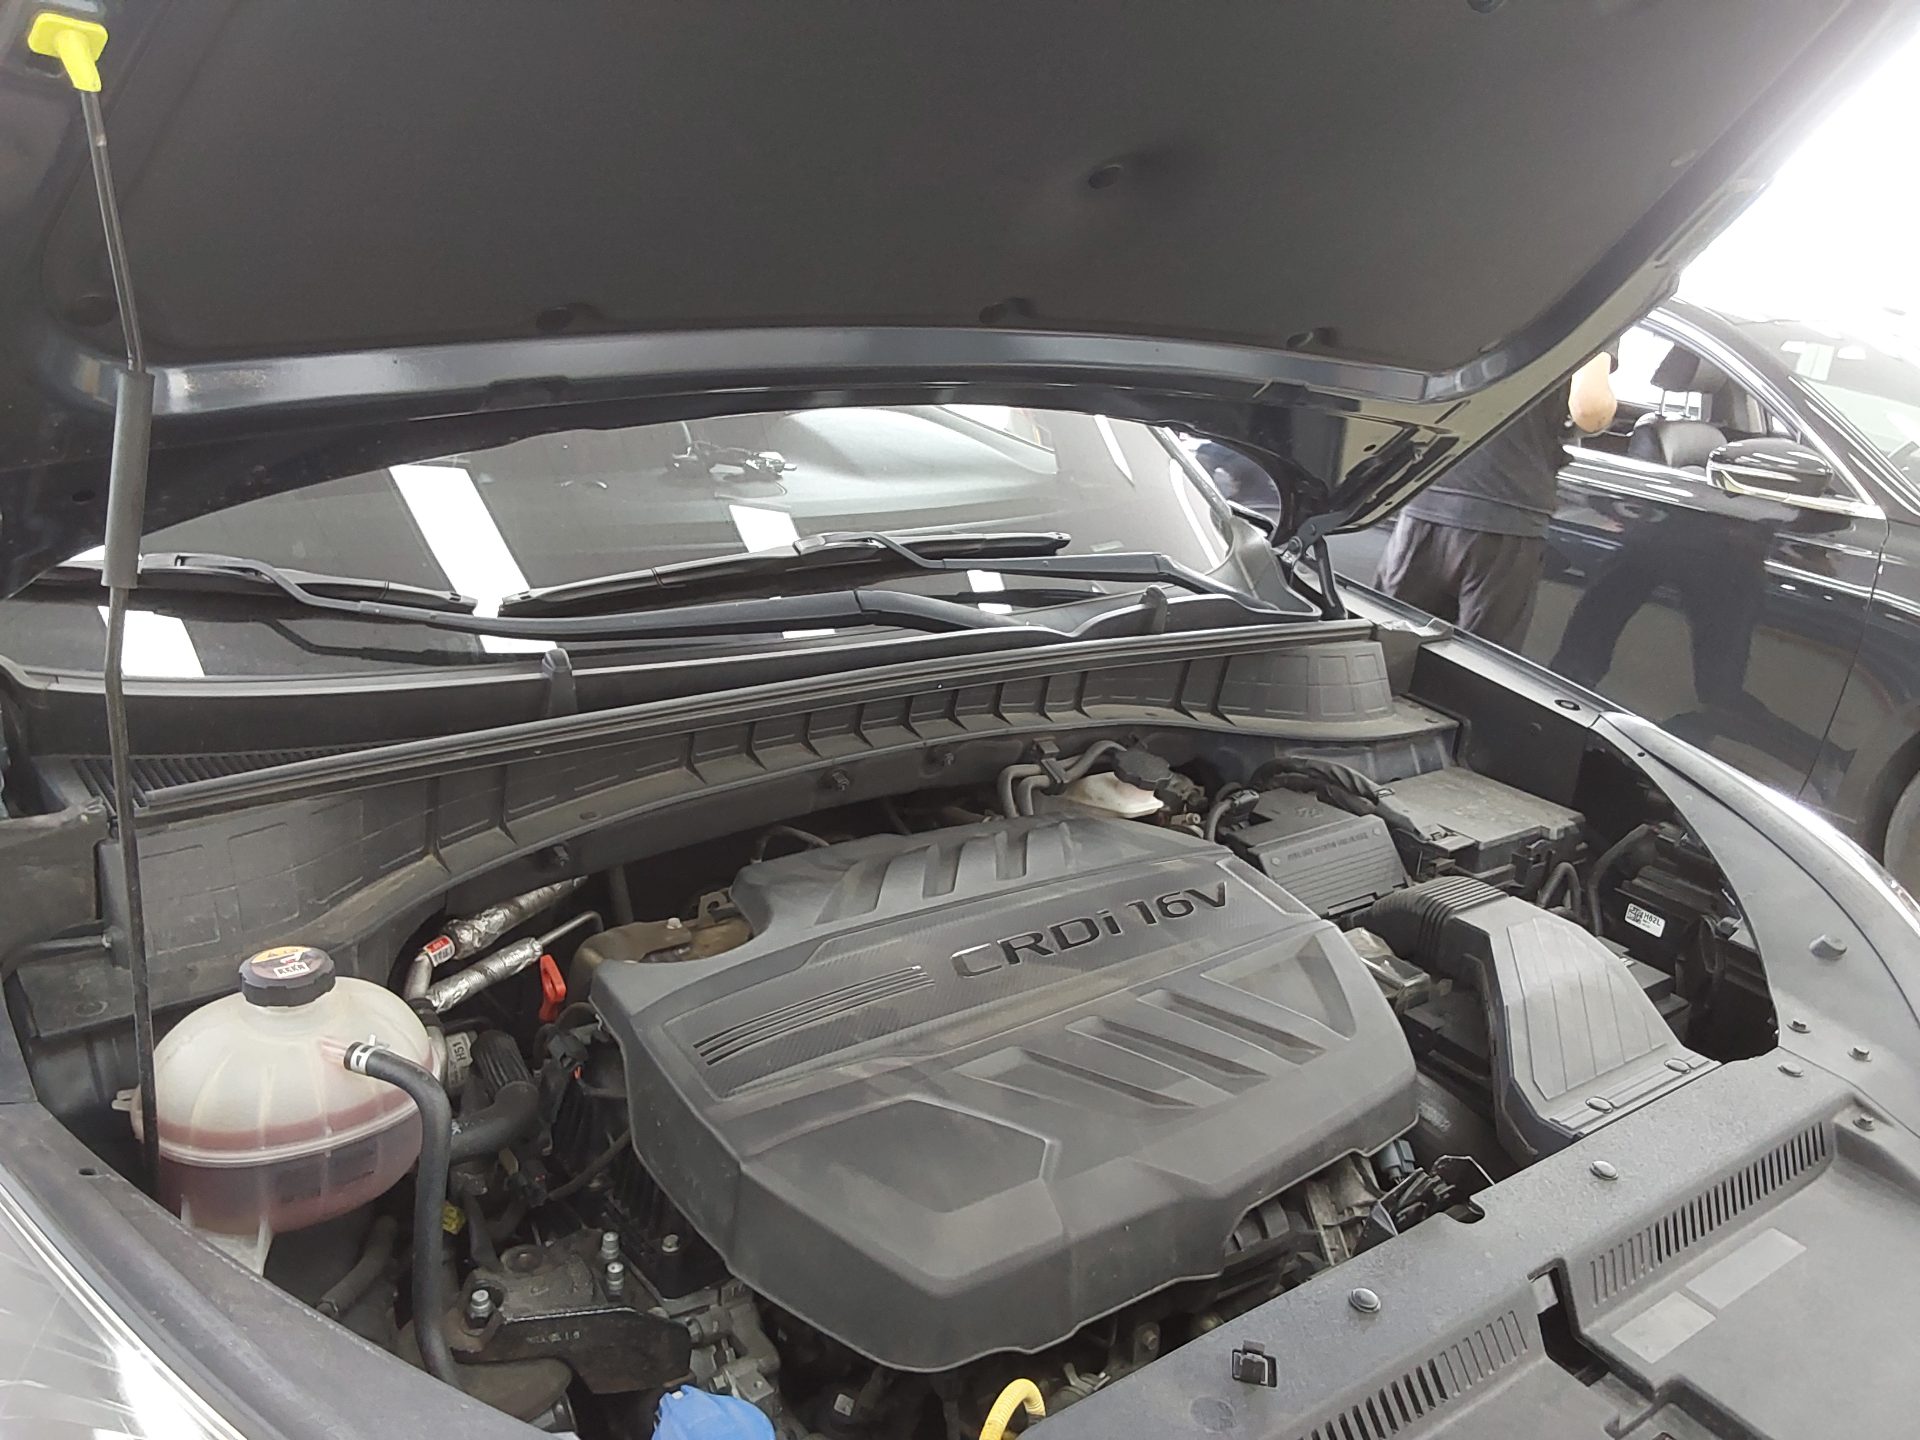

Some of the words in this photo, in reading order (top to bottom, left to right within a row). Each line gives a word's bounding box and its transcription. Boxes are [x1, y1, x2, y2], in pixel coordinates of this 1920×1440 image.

[949, 910, 1122, 978] CRDi
[1126, 882, 1228, 926] 16V
[452, 1041, 468, 1063] H51
